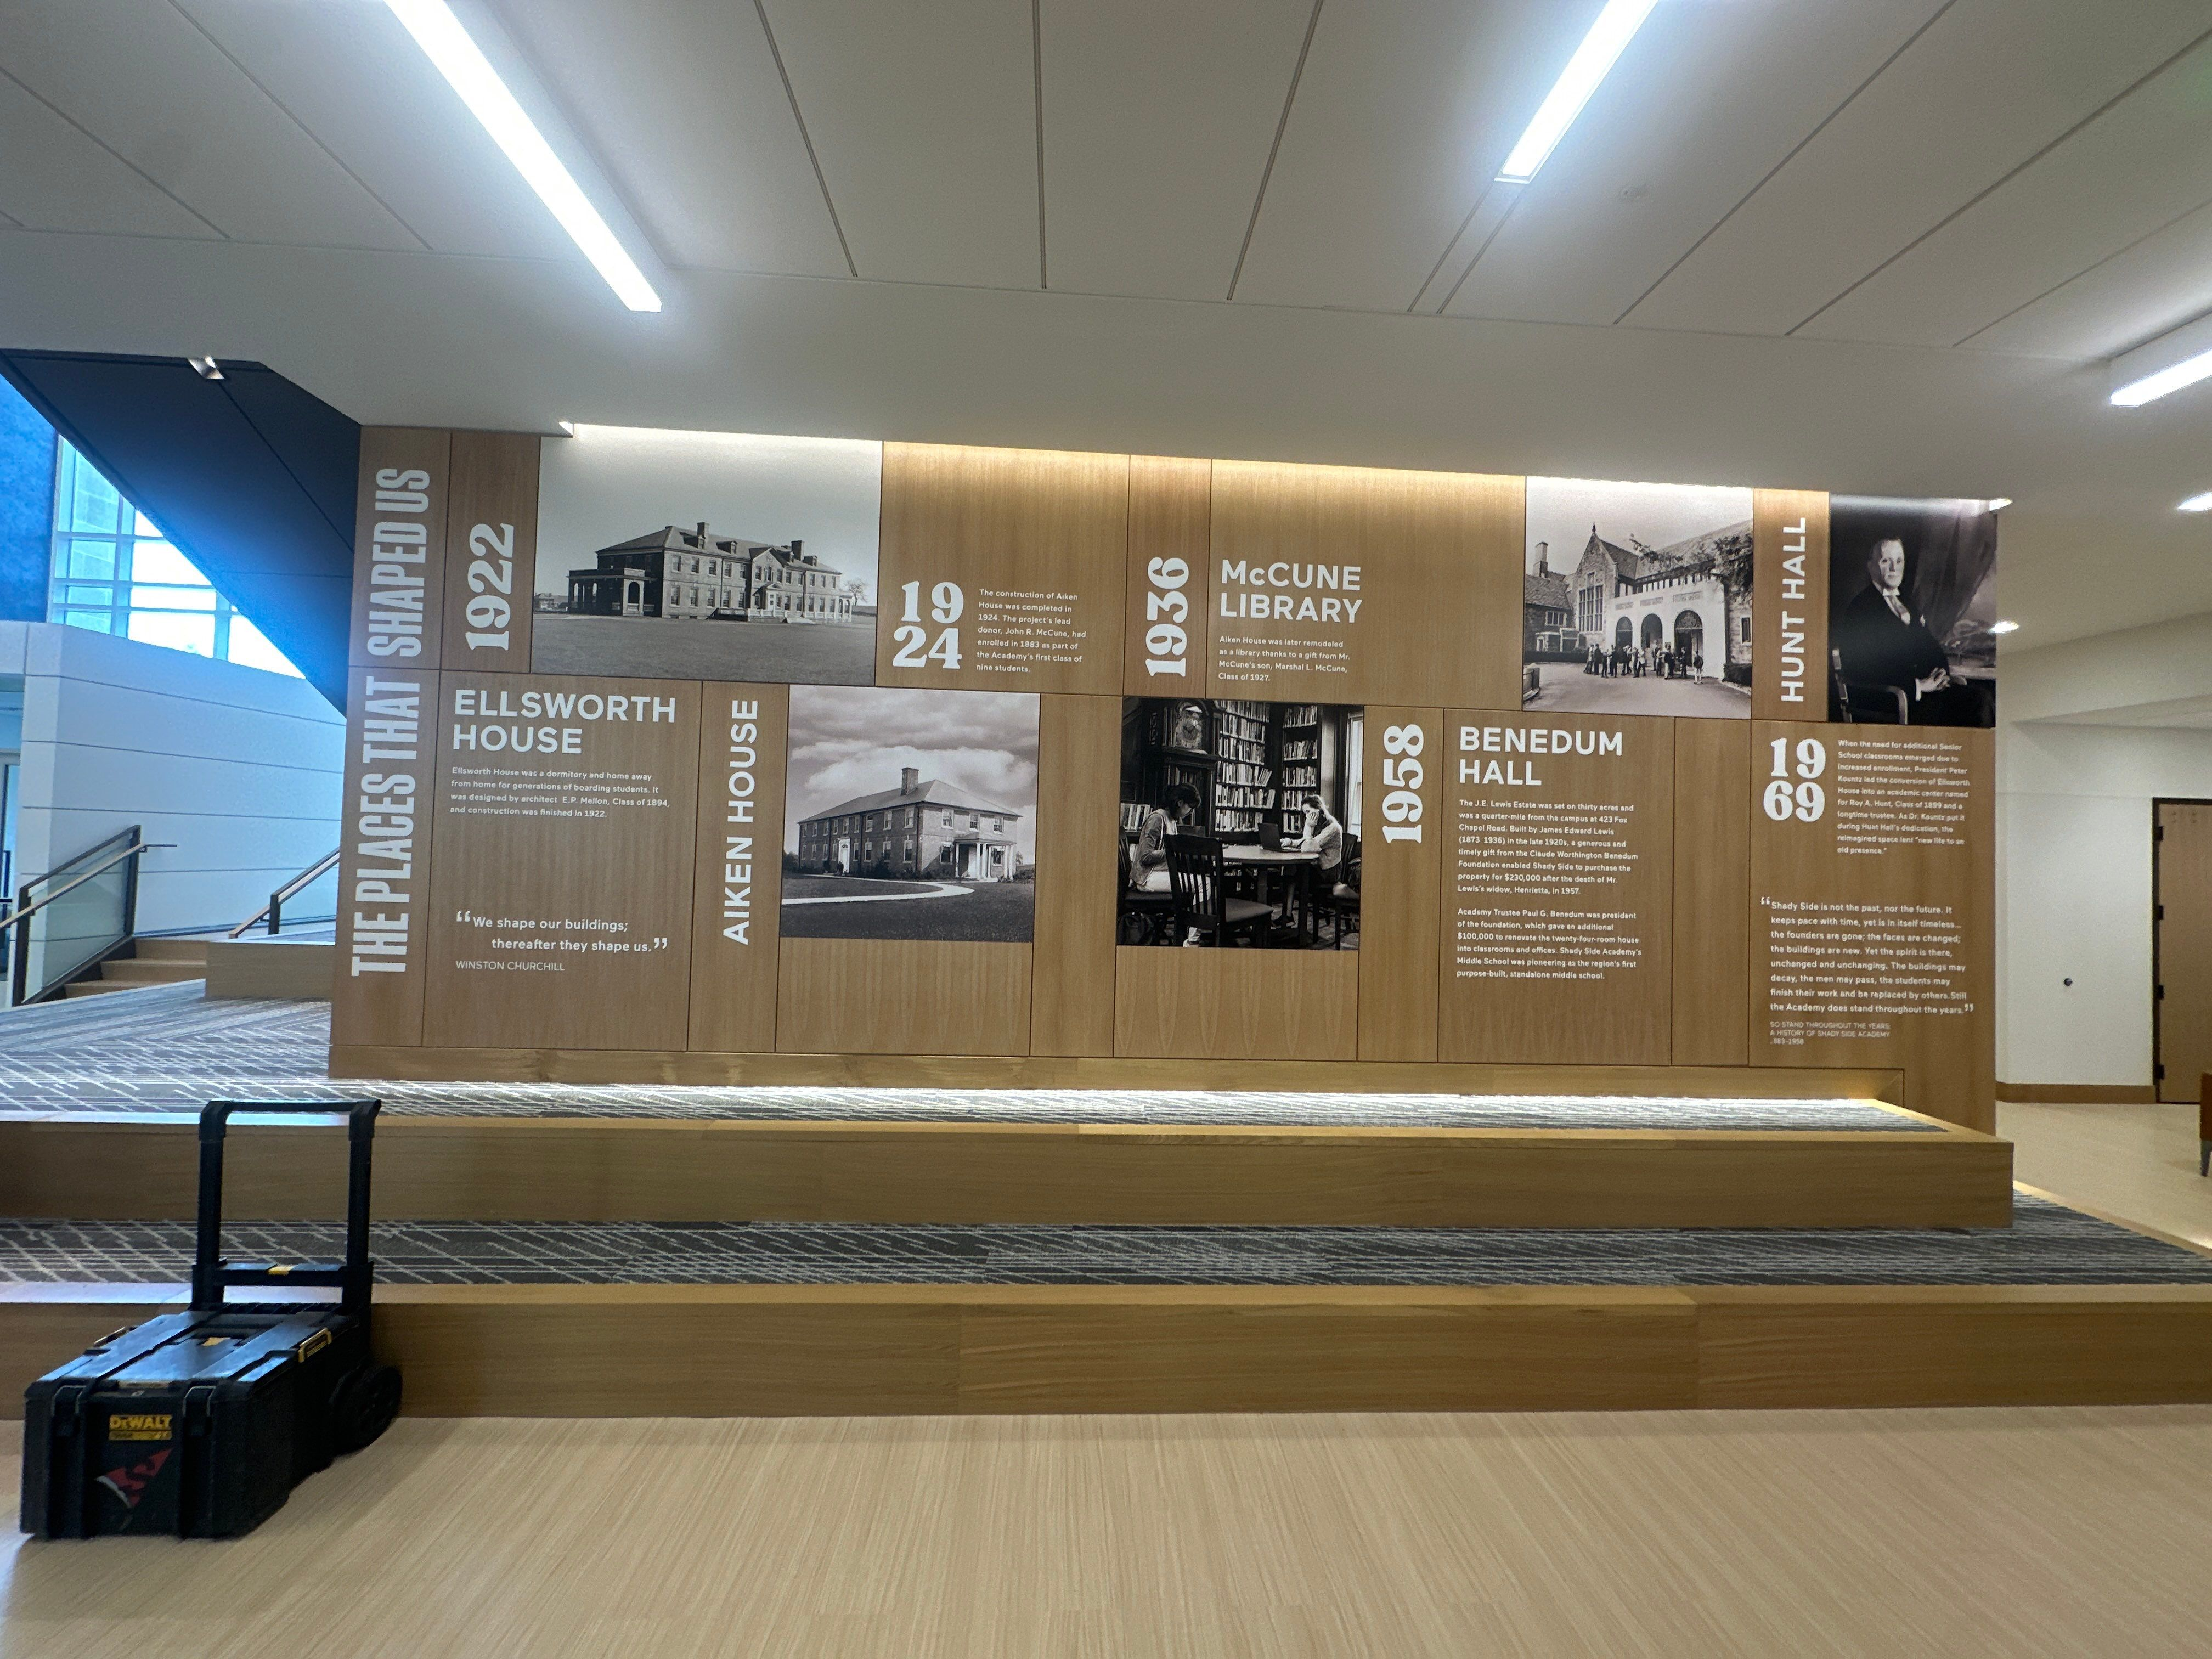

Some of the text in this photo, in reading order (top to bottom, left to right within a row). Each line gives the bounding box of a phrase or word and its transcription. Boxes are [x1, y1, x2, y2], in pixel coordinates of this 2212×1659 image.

[465, 523, 514, 651] 1922
[1221, 559, 1361, 591] McCUNE
[901, 580, 964, 624] 19
[1146, 557, 1189, 677] 1936
[1220, 592, 1363, 623] LIBRARY
[1781, 517, 1806, 702] HUNT HALL
[978, 626, 1002, 635] donor,
[1036, 629, 1069, 637] McCune,
[892, 625, 962, 669] 24
[1235, 648, 1260, 658] library
[1305, 652, 1317, 660] gift
[1315, 664, 1347, 673] McCune,
[454, 689, 676, 723] ELLSWORTH
[351, 468, 430, 977] THE PLACES THAT SHAPED US
[453, 724, 583, 754] HOUSE
[1459, 726, 1623, 756] BENEDUM
[452, 766, 491, 775] Ellsworth
[546, 770, 587, 780] dormitory
[1459, 759, 1542, 786] HALL
[1770, 737, 1826, 779] 19
[574, 784, 611, 793] boarding
[1382, 724, 1424, 843] 1958
[469, 793, 507, 802] designed
[509, 794, 519, 803] by
[521, 795, 557, 803] architect
[580, 797, 610, 805] Mellon,
[647, 799, 670, 808] 1894,
[540, 808, 573, 816] finished
[1577, 803, 1598, 811] thirty
[1763, 780, 1825, 822] 69
[723, 699, 758, 945] AIKEN HOUSE
[1457, 908, 1492, 917] Academy
[1799, 902, 1819, 910] Side
[497, 917, 535, 930] shape
[539, 921, 562, 929] our
[565, 918, 628, 933] buildings;
[492, 938, 556, 949] thereafter
[559, 939, 588, 952] they
[591, 940, 629, 953] shape
[456, 961, 565, 971] WINSTON CHURCHILL
